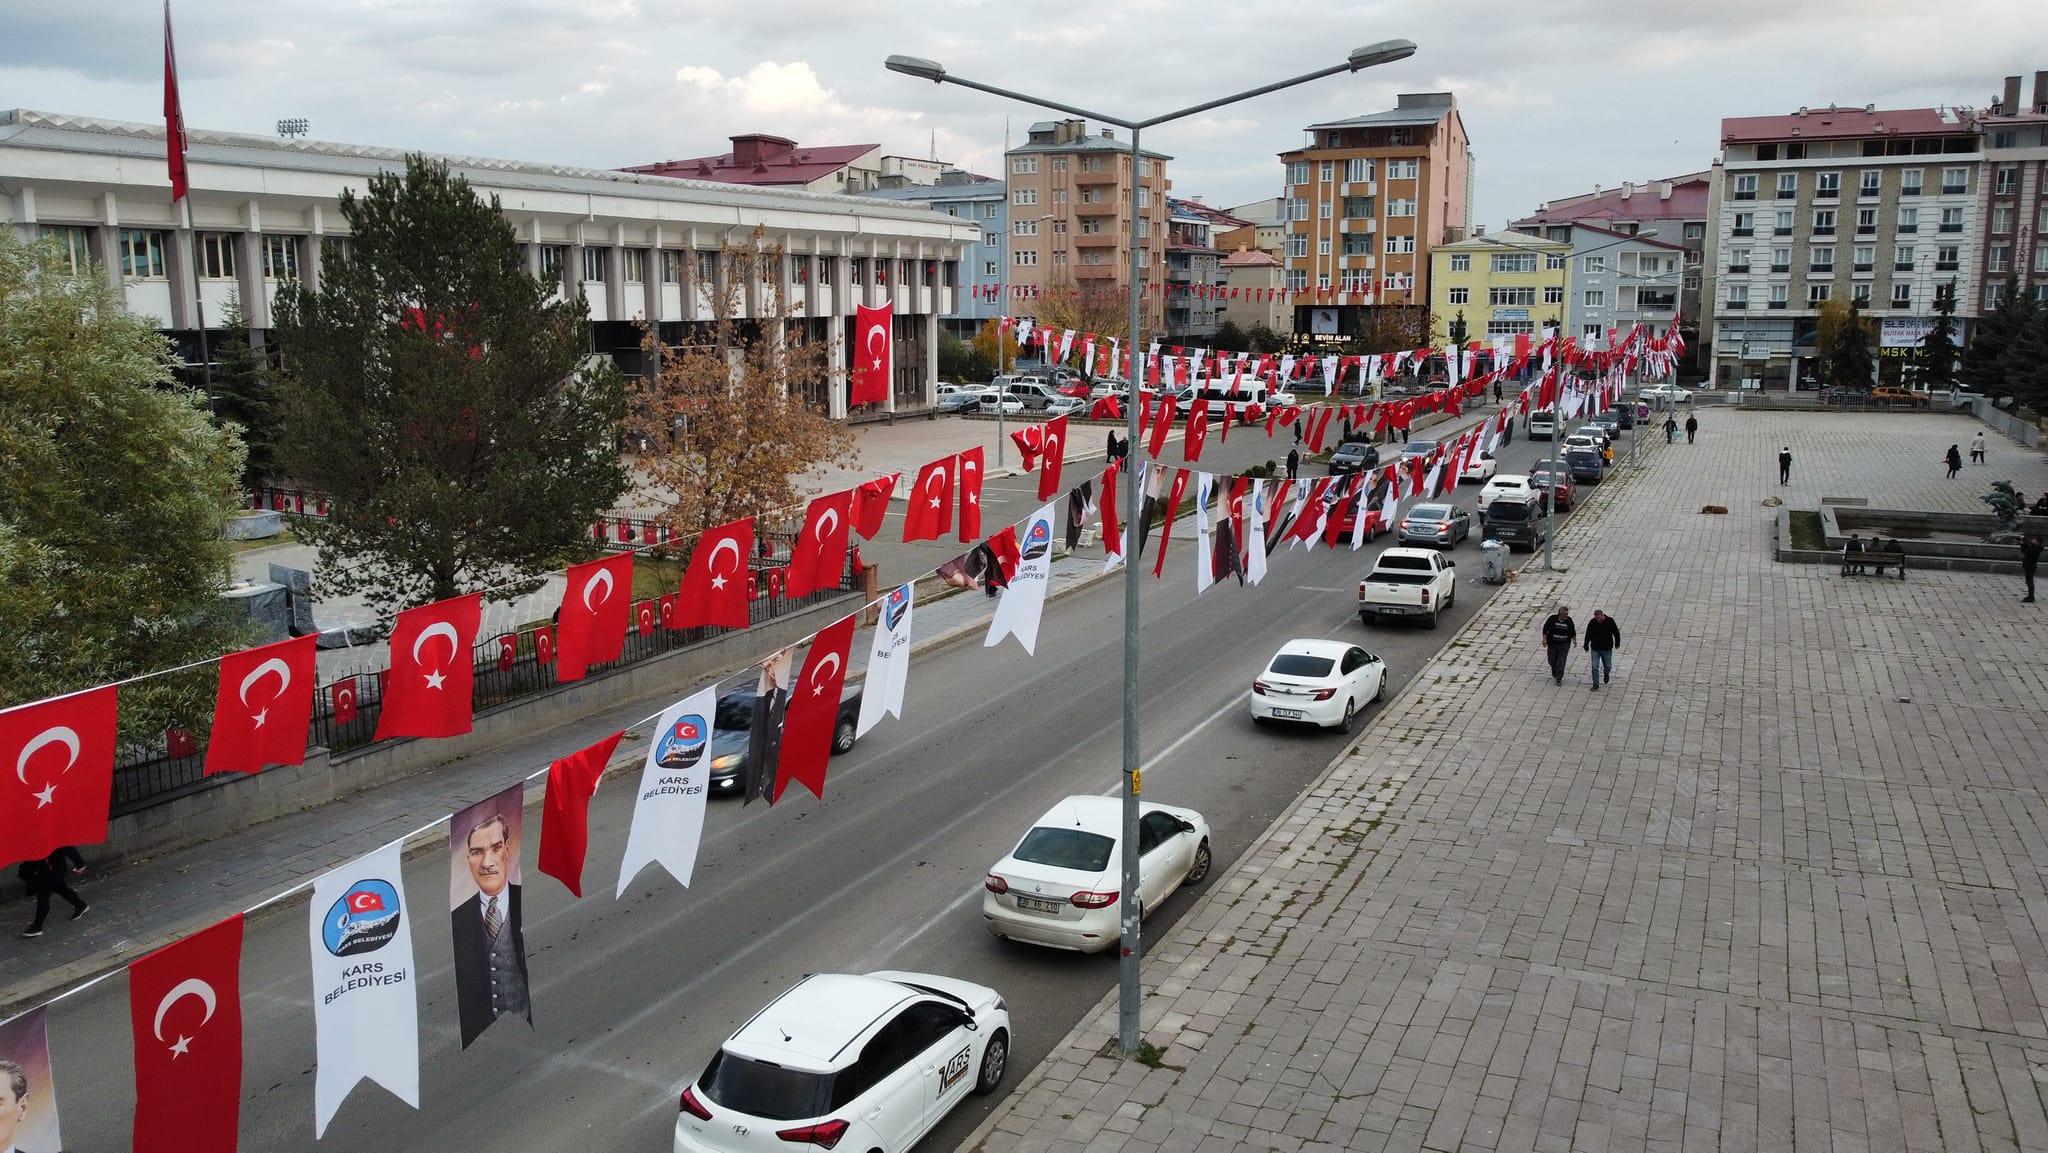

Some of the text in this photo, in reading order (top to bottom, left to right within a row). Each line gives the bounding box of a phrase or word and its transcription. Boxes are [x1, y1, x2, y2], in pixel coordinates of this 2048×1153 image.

[1880, 347, 1908, 357] MSK
[659, 777, 689, 785] KARS
[643, 784, 703, 800] BELEDİYESİ
[353, 932, 393, 944] BELEDİYESİ
[342, 962, 384, 980] KARS
[324, 968, 406, 1005] BELEDİYESİ
